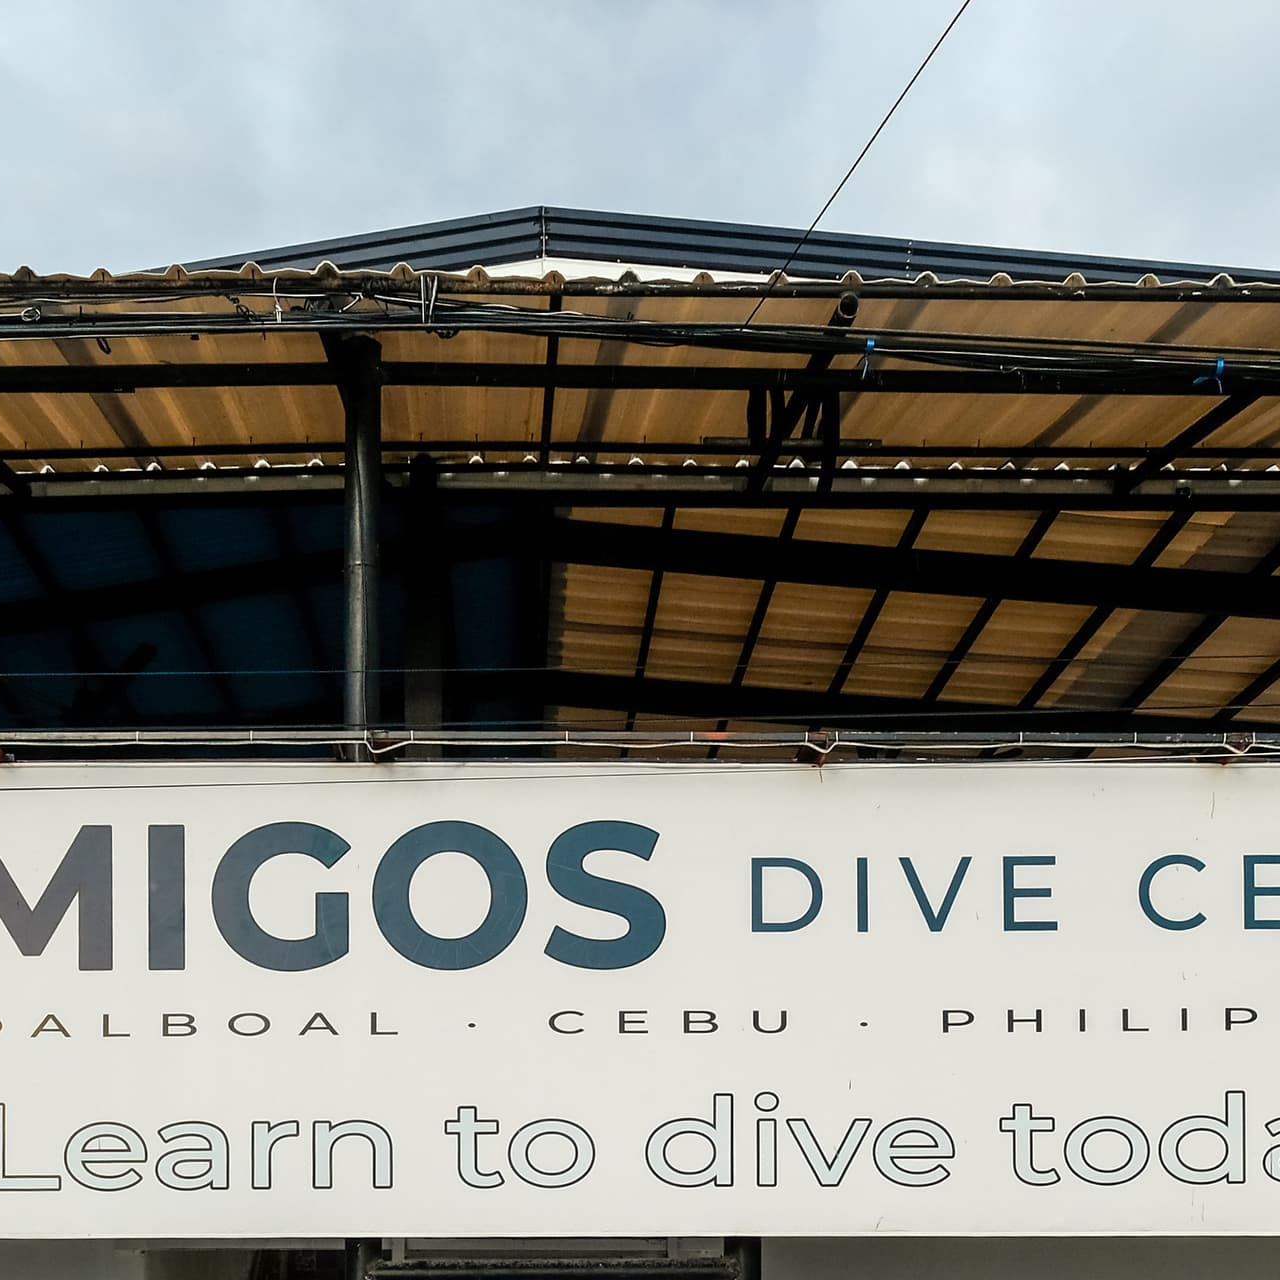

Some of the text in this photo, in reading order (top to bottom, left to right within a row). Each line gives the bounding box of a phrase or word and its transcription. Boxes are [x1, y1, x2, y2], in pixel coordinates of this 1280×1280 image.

[751, 856, 1058, 932] DIVE
[549, 1011, 787, 1034] CEBU
[444, 1105, 596, 1190] to
[645, 1090, 955, 1189] dive
